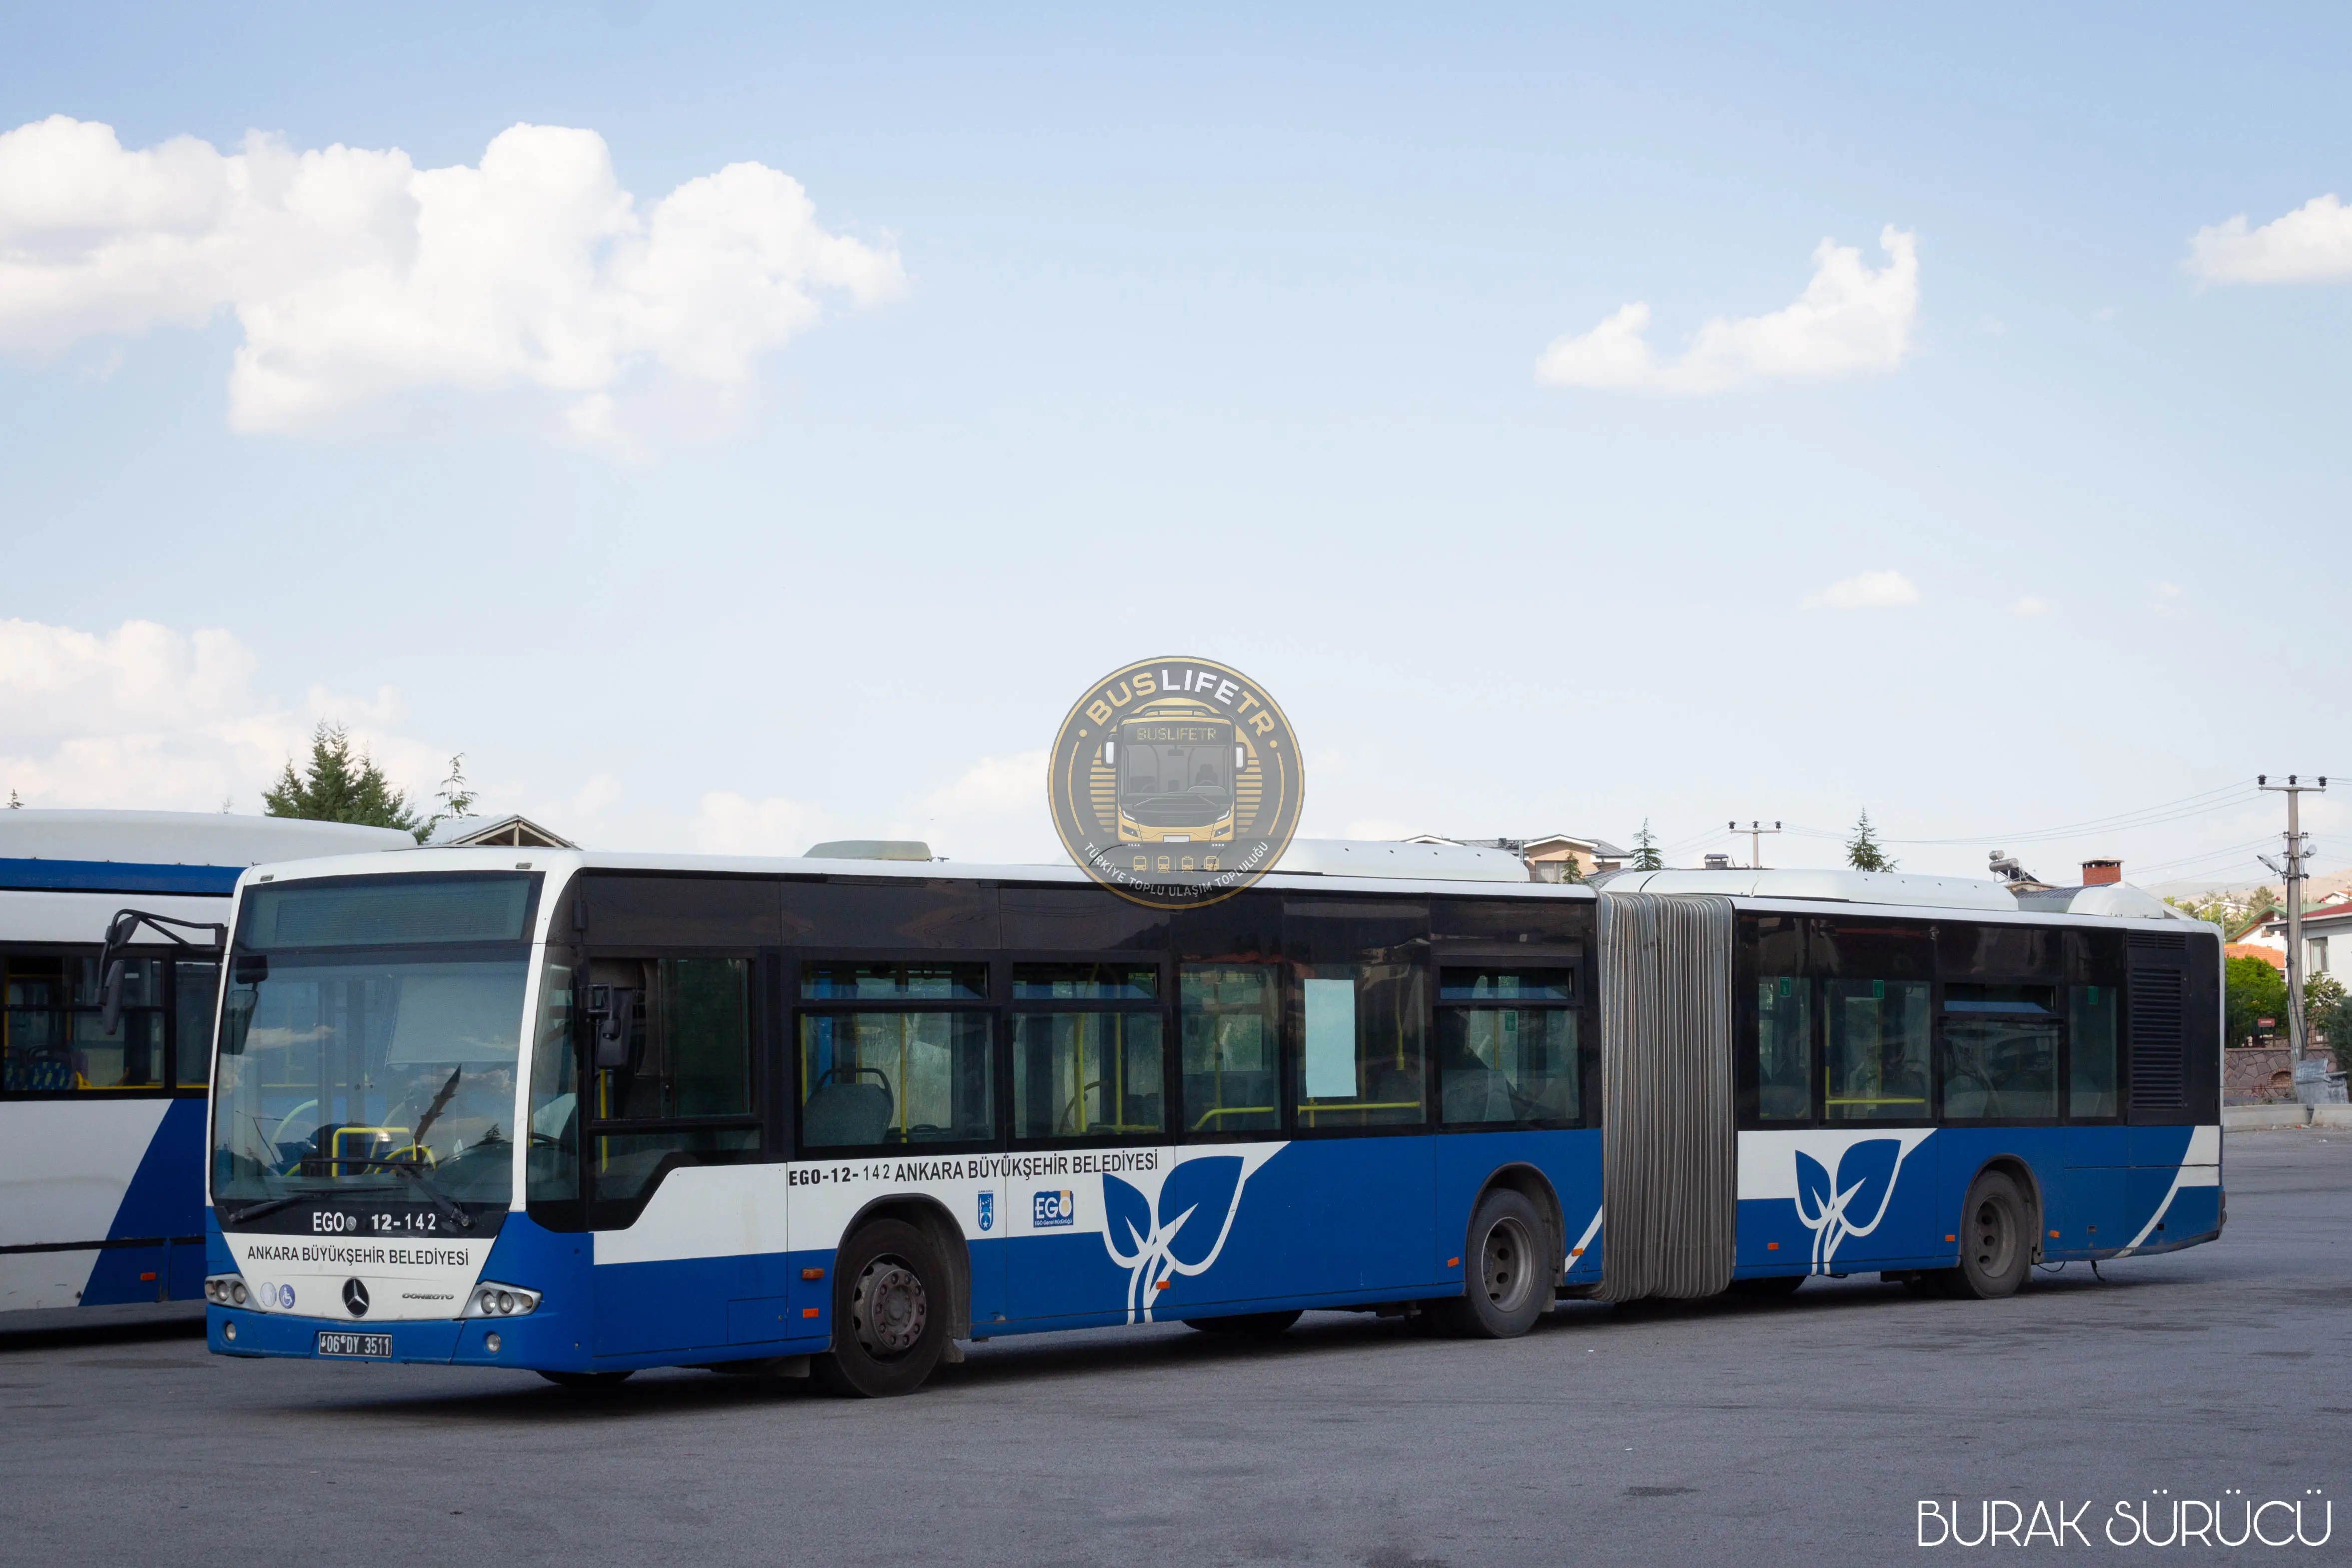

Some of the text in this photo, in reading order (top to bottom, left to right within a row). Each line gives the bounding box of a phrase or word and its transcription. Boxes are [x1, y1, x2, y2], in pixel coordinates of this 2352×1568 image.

[894, 1161, 964, 1182] ANKARA
[968, 1153, 1068, 1180] BÜYÜKŞEHİR
[1073, 1148, 1158, 1174] BELEDİYESİ
[1035, 1196, 1072, 1219] EGO
[313, 1212, 344, 1232] EGO
[247, 1245, 469, 1266] ANKARA BÜYÜKŞEHİR BELEDİYESİ
[327, 1335, 389, 1355] 06 DY 3511
